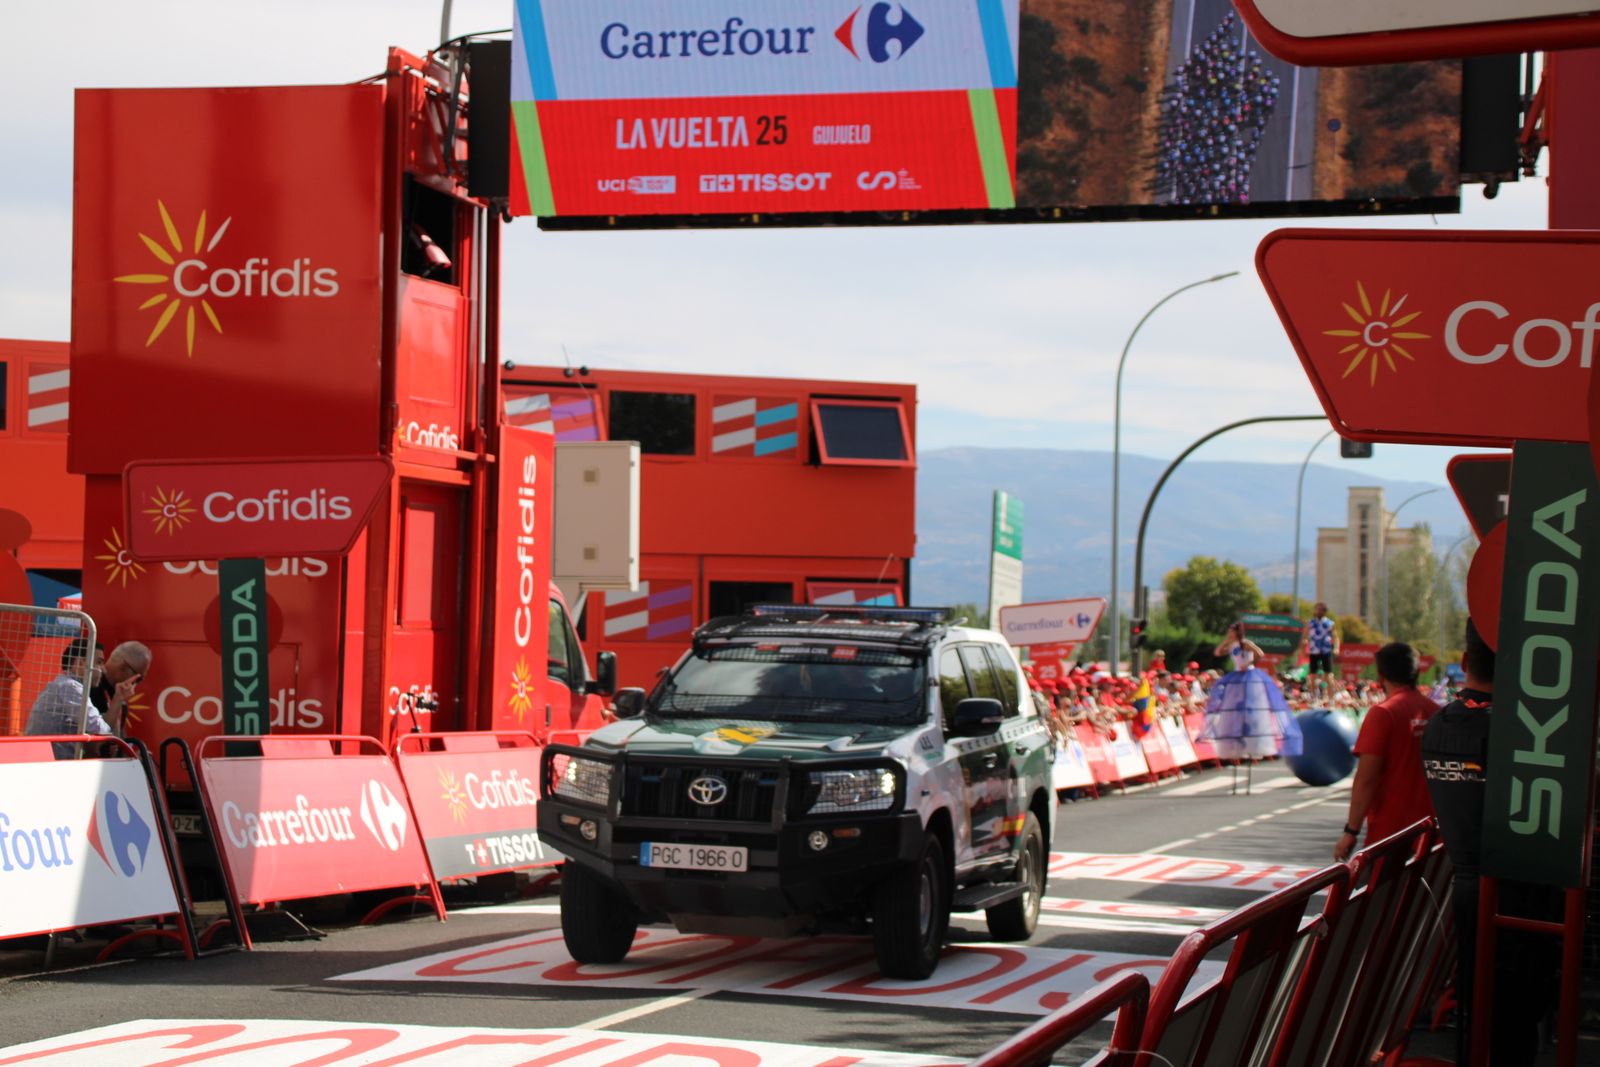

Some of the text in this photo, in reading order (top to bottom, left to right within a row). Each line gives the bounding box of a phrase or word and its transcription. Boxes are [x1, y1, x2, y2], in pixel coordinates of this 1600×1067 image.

[600, 17, 815, 59] Carrefour
[616, 115, 788, 149] LA VUELTA 25
[597, 179, 625, 192] UCI
[737, 172, 832, 192] TISSOT
[174, 258, 340, 298] Cofidis
[203, 488, 352, 523] Cofidis
[515, 454, 537, 647] Cofidis
[1508, 488, 1588, 840] ŠKODA
[157, 686, 324, 728] Codis
[464, 768, 538, 810] Cofidis
[222, 794, 357, 849] Carrefour
[485, 832, 545, 865] TISSOT
[651, 846, 681, 864] PGC
[688, 848, 727, 867] 1966
